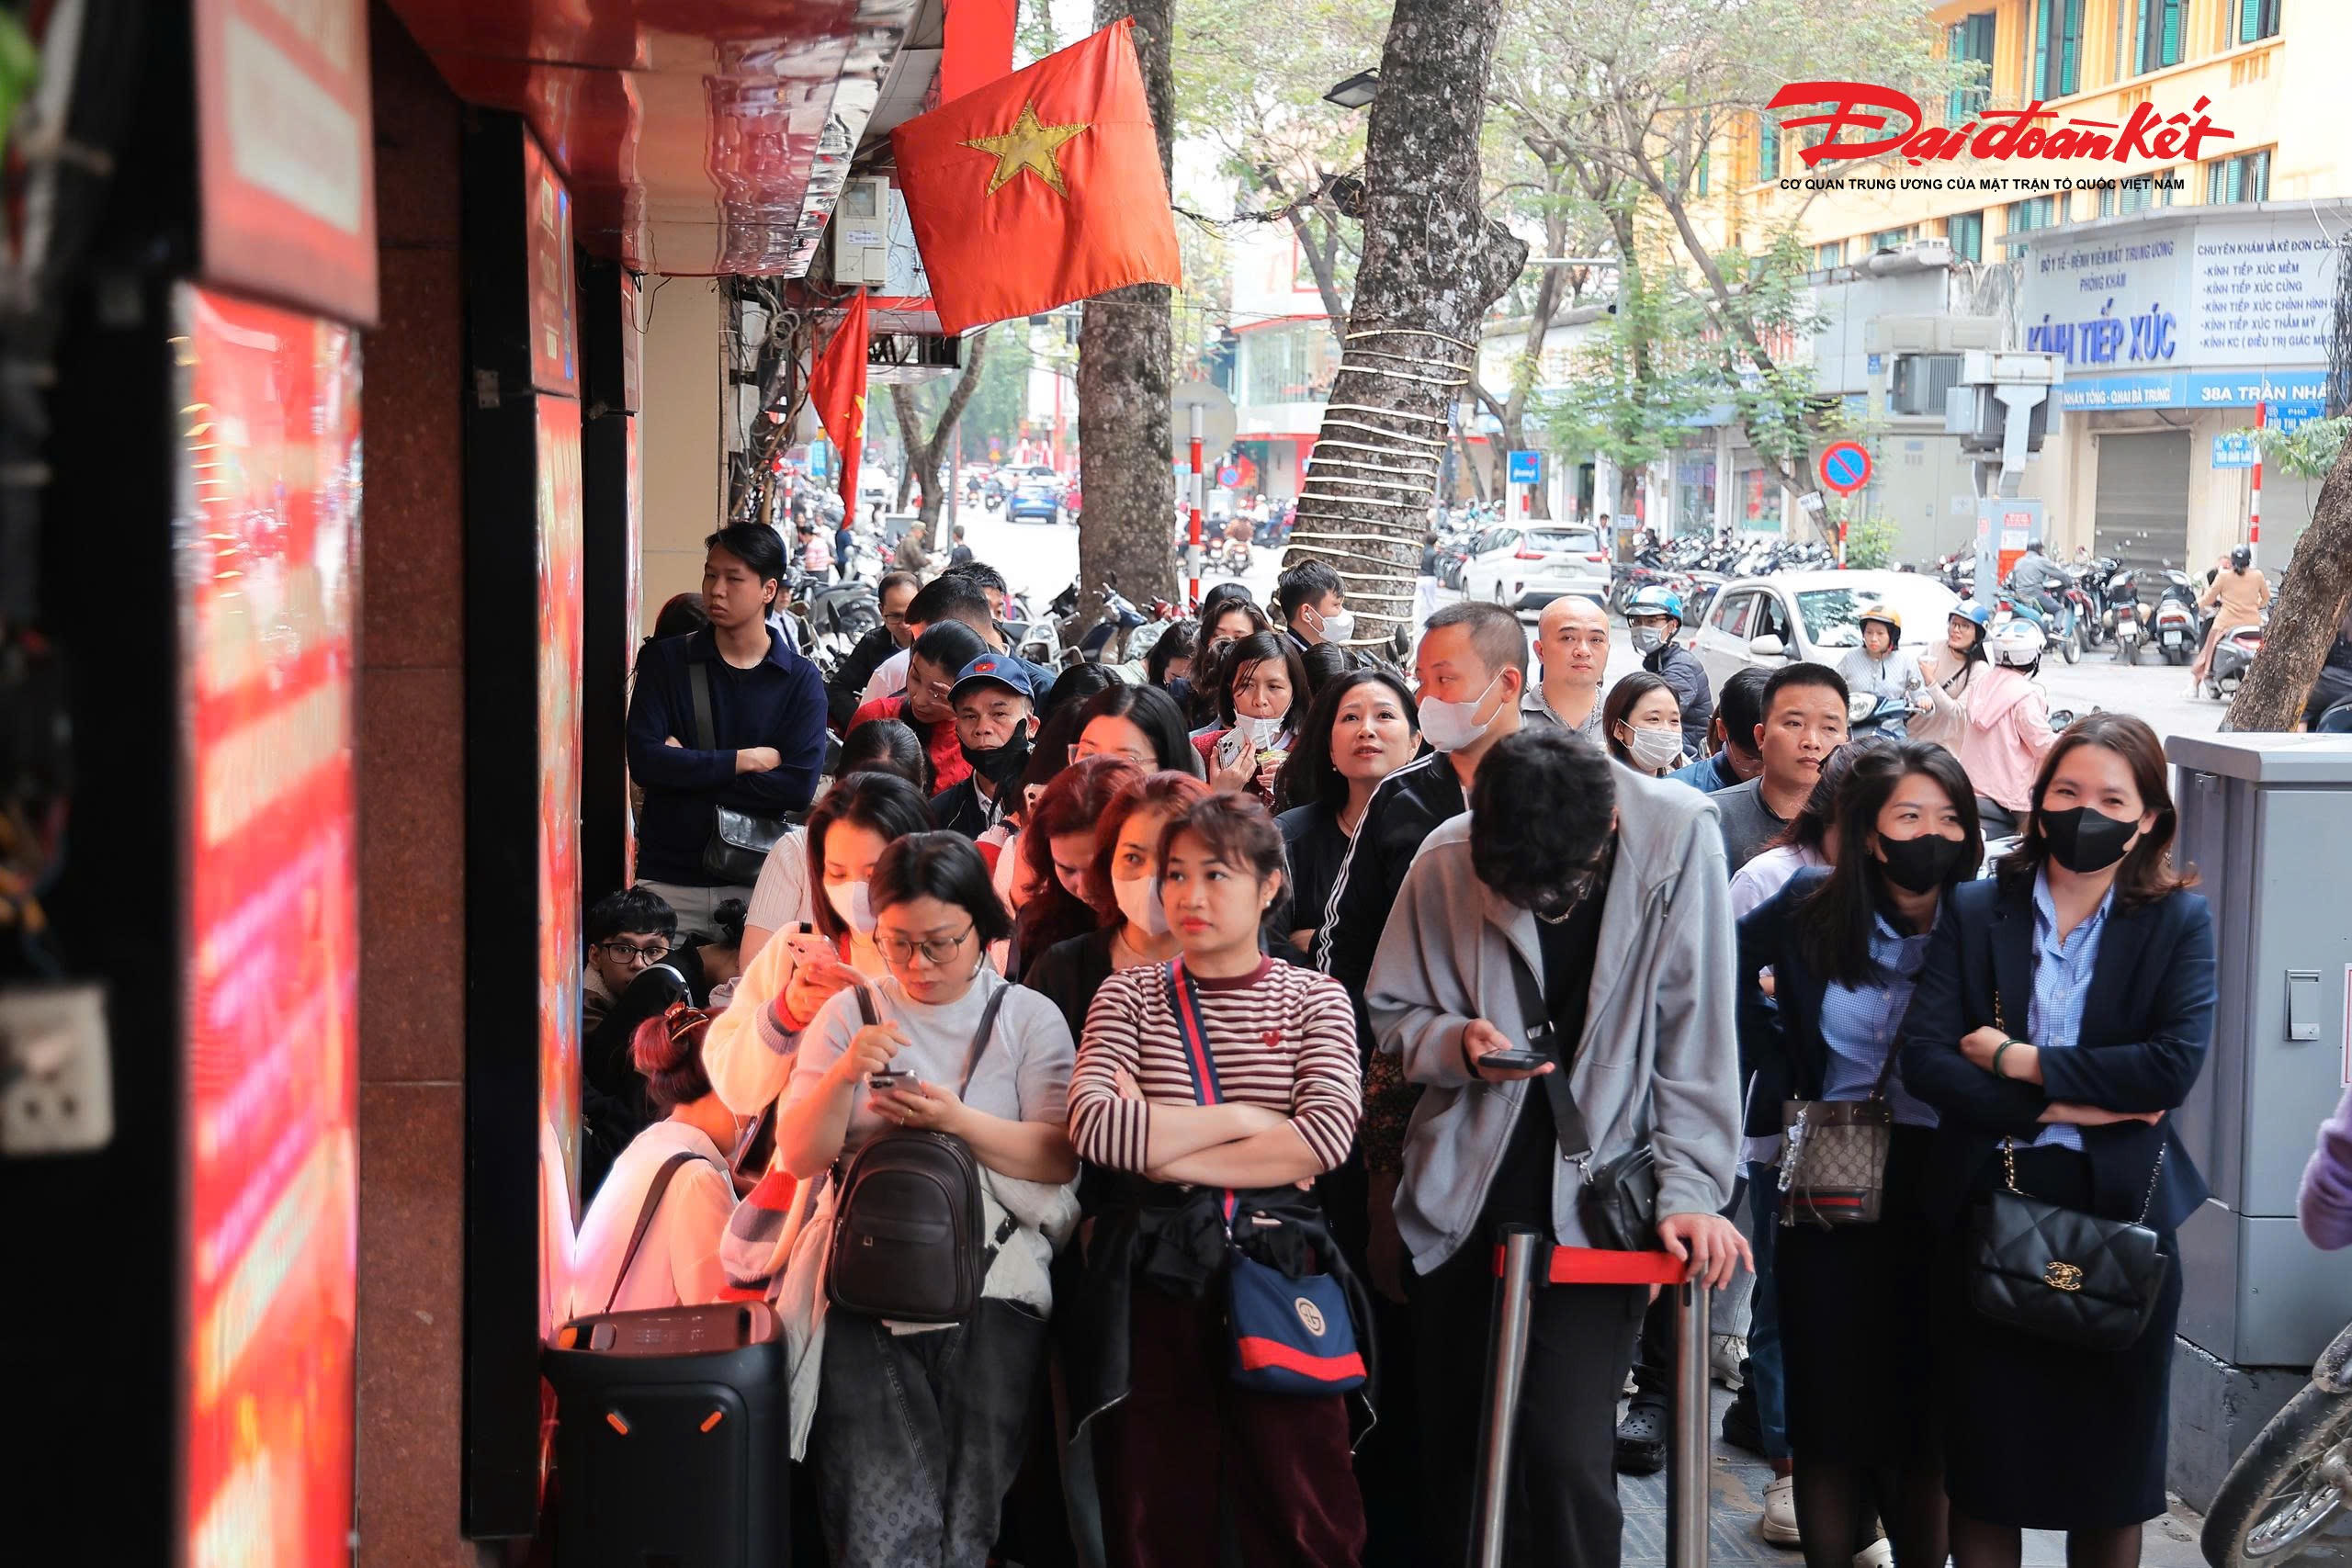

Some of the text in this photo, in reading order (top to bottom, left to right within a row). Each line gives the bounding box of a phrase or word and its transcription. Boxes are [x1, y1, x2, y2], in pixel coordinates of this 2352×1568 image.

[2197, 242, 2236, 256] CHUYÊN
[2237, 240, 2264, 254] KHÁM
[2233, 260, 2253, 275] TIẾP
[2256, 261, 2276, 275] XÚC
[2232, 278, 2251, 294] TIẾP
[2254, 279, 2273, 293] XÚC
[2230, 296, 2250, 312] TIẾP
[2253, 298, 2272, 312] XÚC
[2228, 313, 2249, 331] TIẾP
[2252, 316, 2271, 331] XÚC
[2027, 298, 2177, 364] KÍNH TIẾP XÚC
[2201, 379, 2327, 401] 38A TRẦN NHÂ
